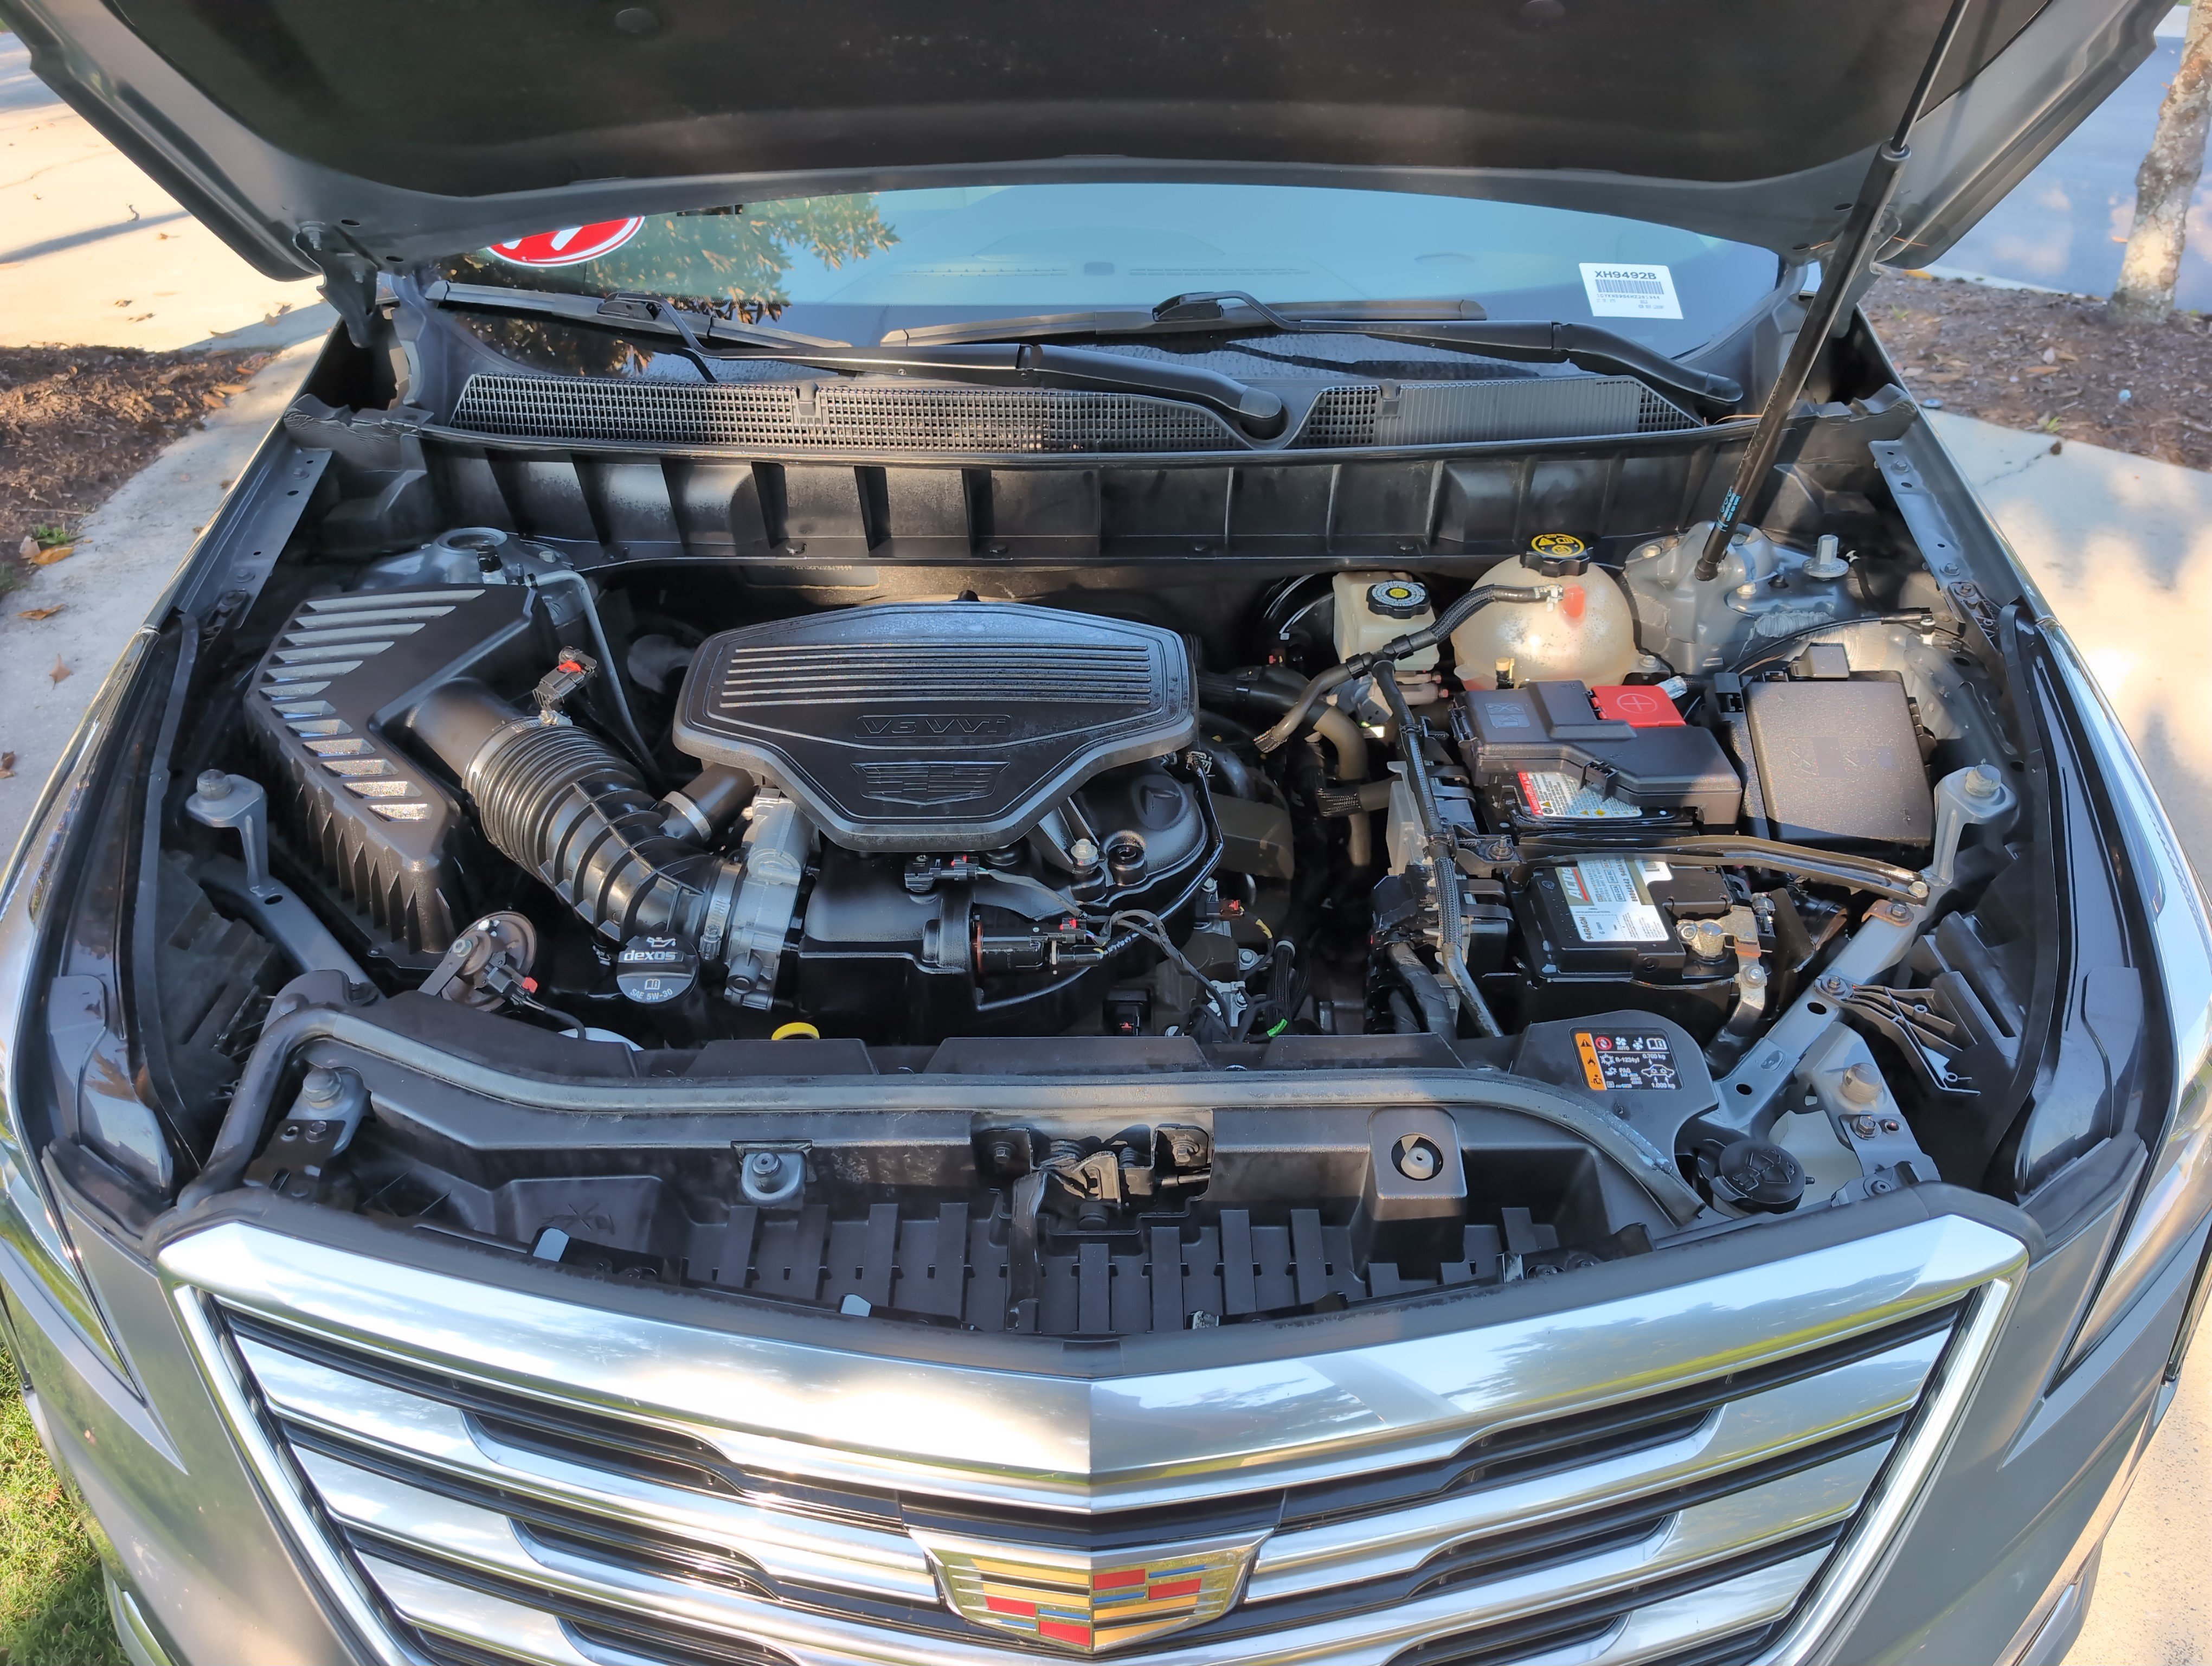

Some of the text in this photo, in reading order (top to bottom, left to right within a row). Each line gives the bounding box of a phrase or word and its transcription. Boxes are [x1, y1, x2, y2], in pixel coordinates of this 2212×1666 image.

[1595, 271, 1657, 280] XH9492B
[1561, 868, 1584, 900] ACDe
[1579, 917, 1593, 939] 94RAGM
[624, 950, 676, 961] dexos
[630, 988, 673, 1000] SAE 5W-30
